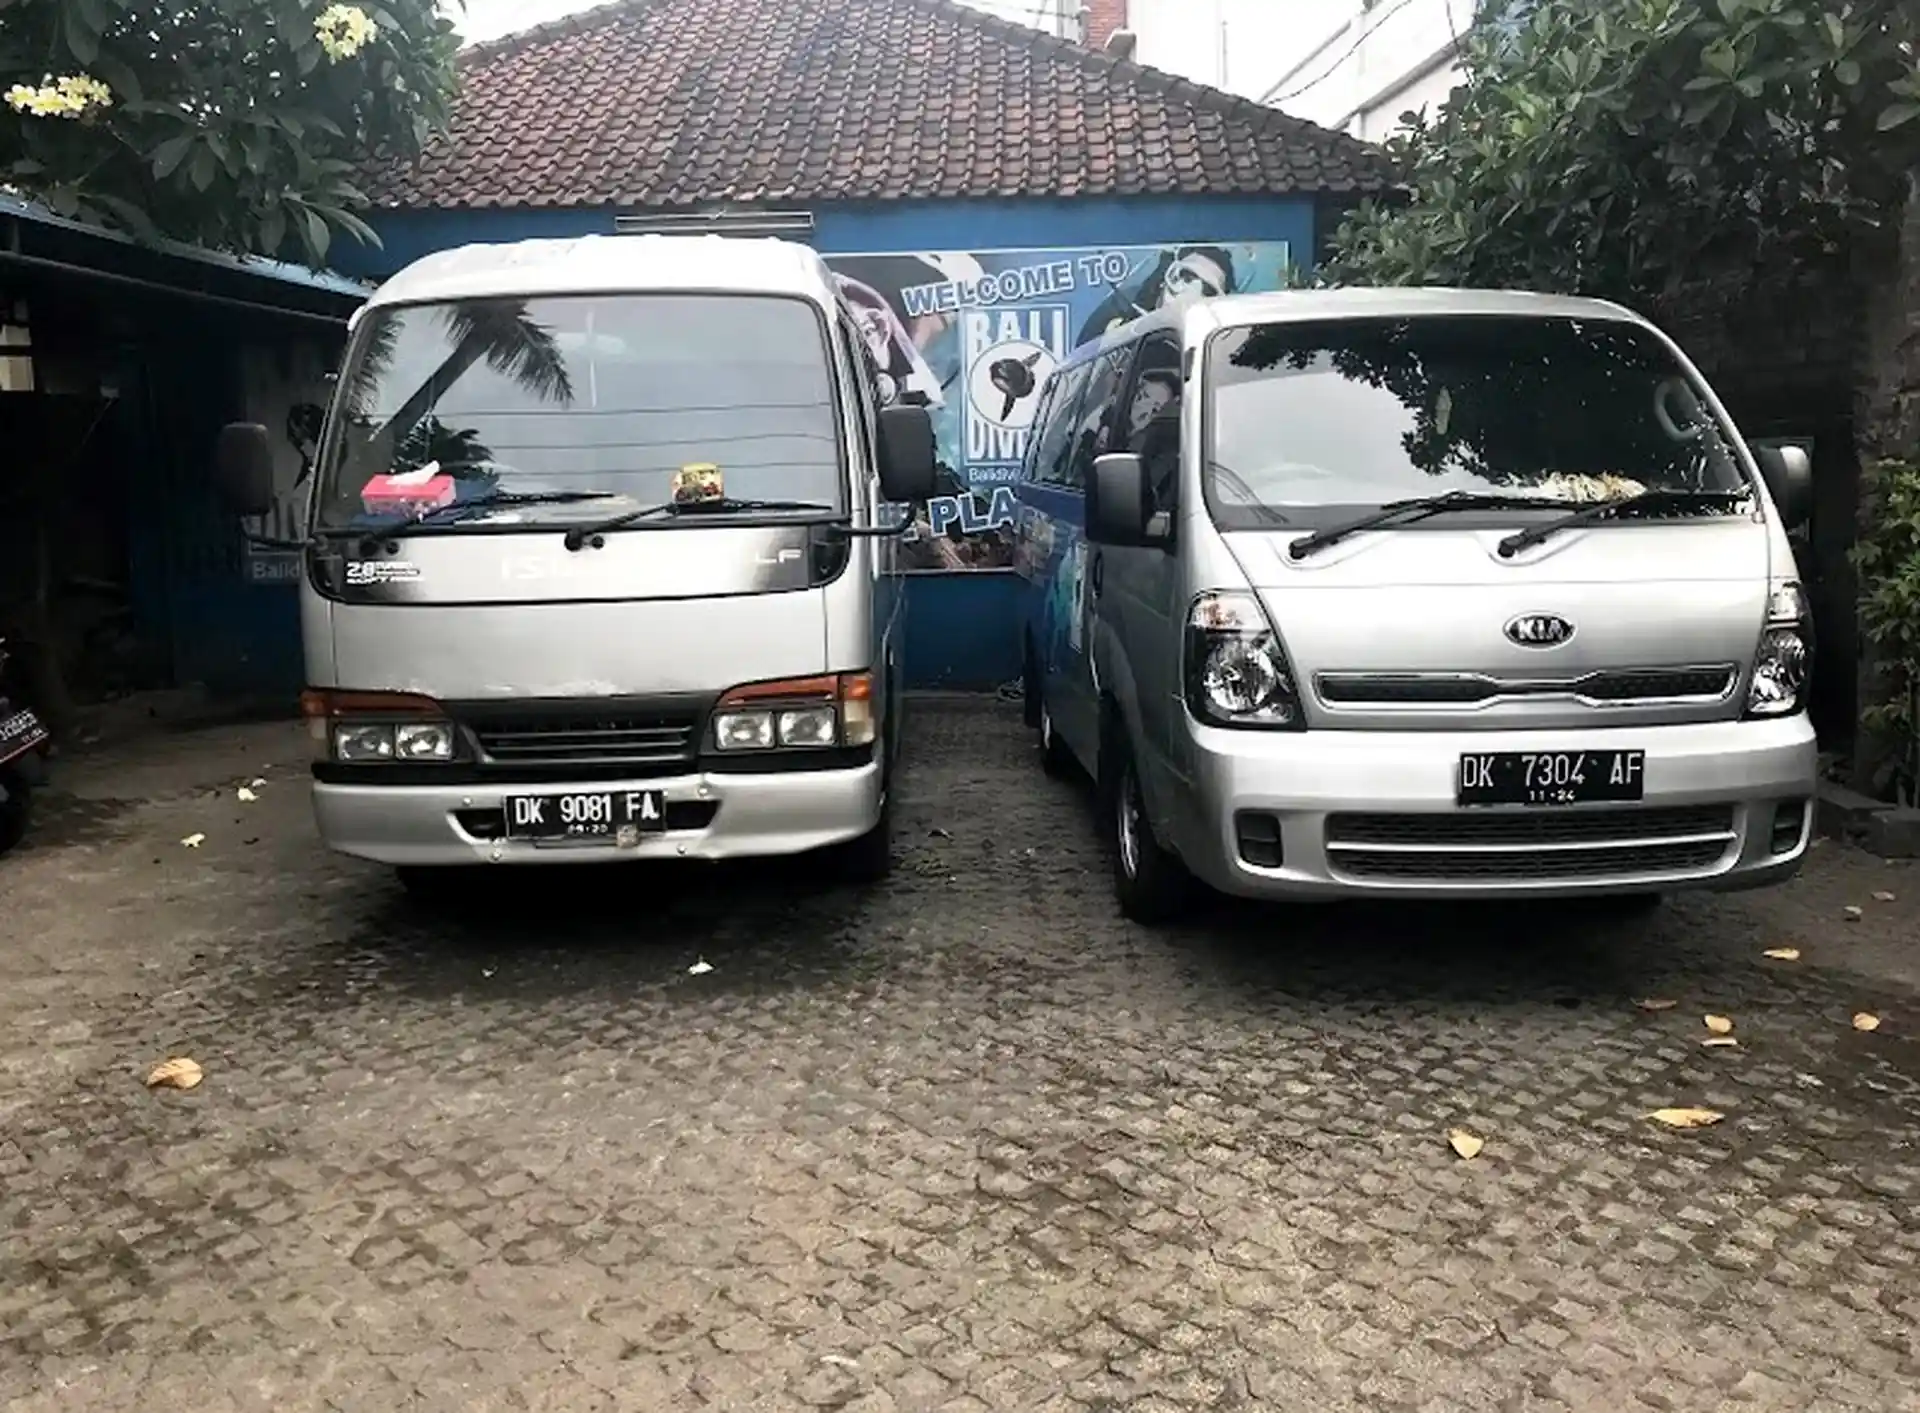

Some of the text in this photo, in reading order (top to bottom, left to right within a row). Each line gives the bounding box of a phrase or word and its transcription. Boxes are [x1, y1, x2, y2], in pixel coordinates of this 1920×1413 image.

[901, 251, 1129, 317] WELCOME TO
[966, 309, 1065, 364] BALI
[1518, 619, 1563, 639] KIA
[1463, 753, 1642, 787] DK 7304 AF
[515, 792, 660, 824] DK 9081 FA
